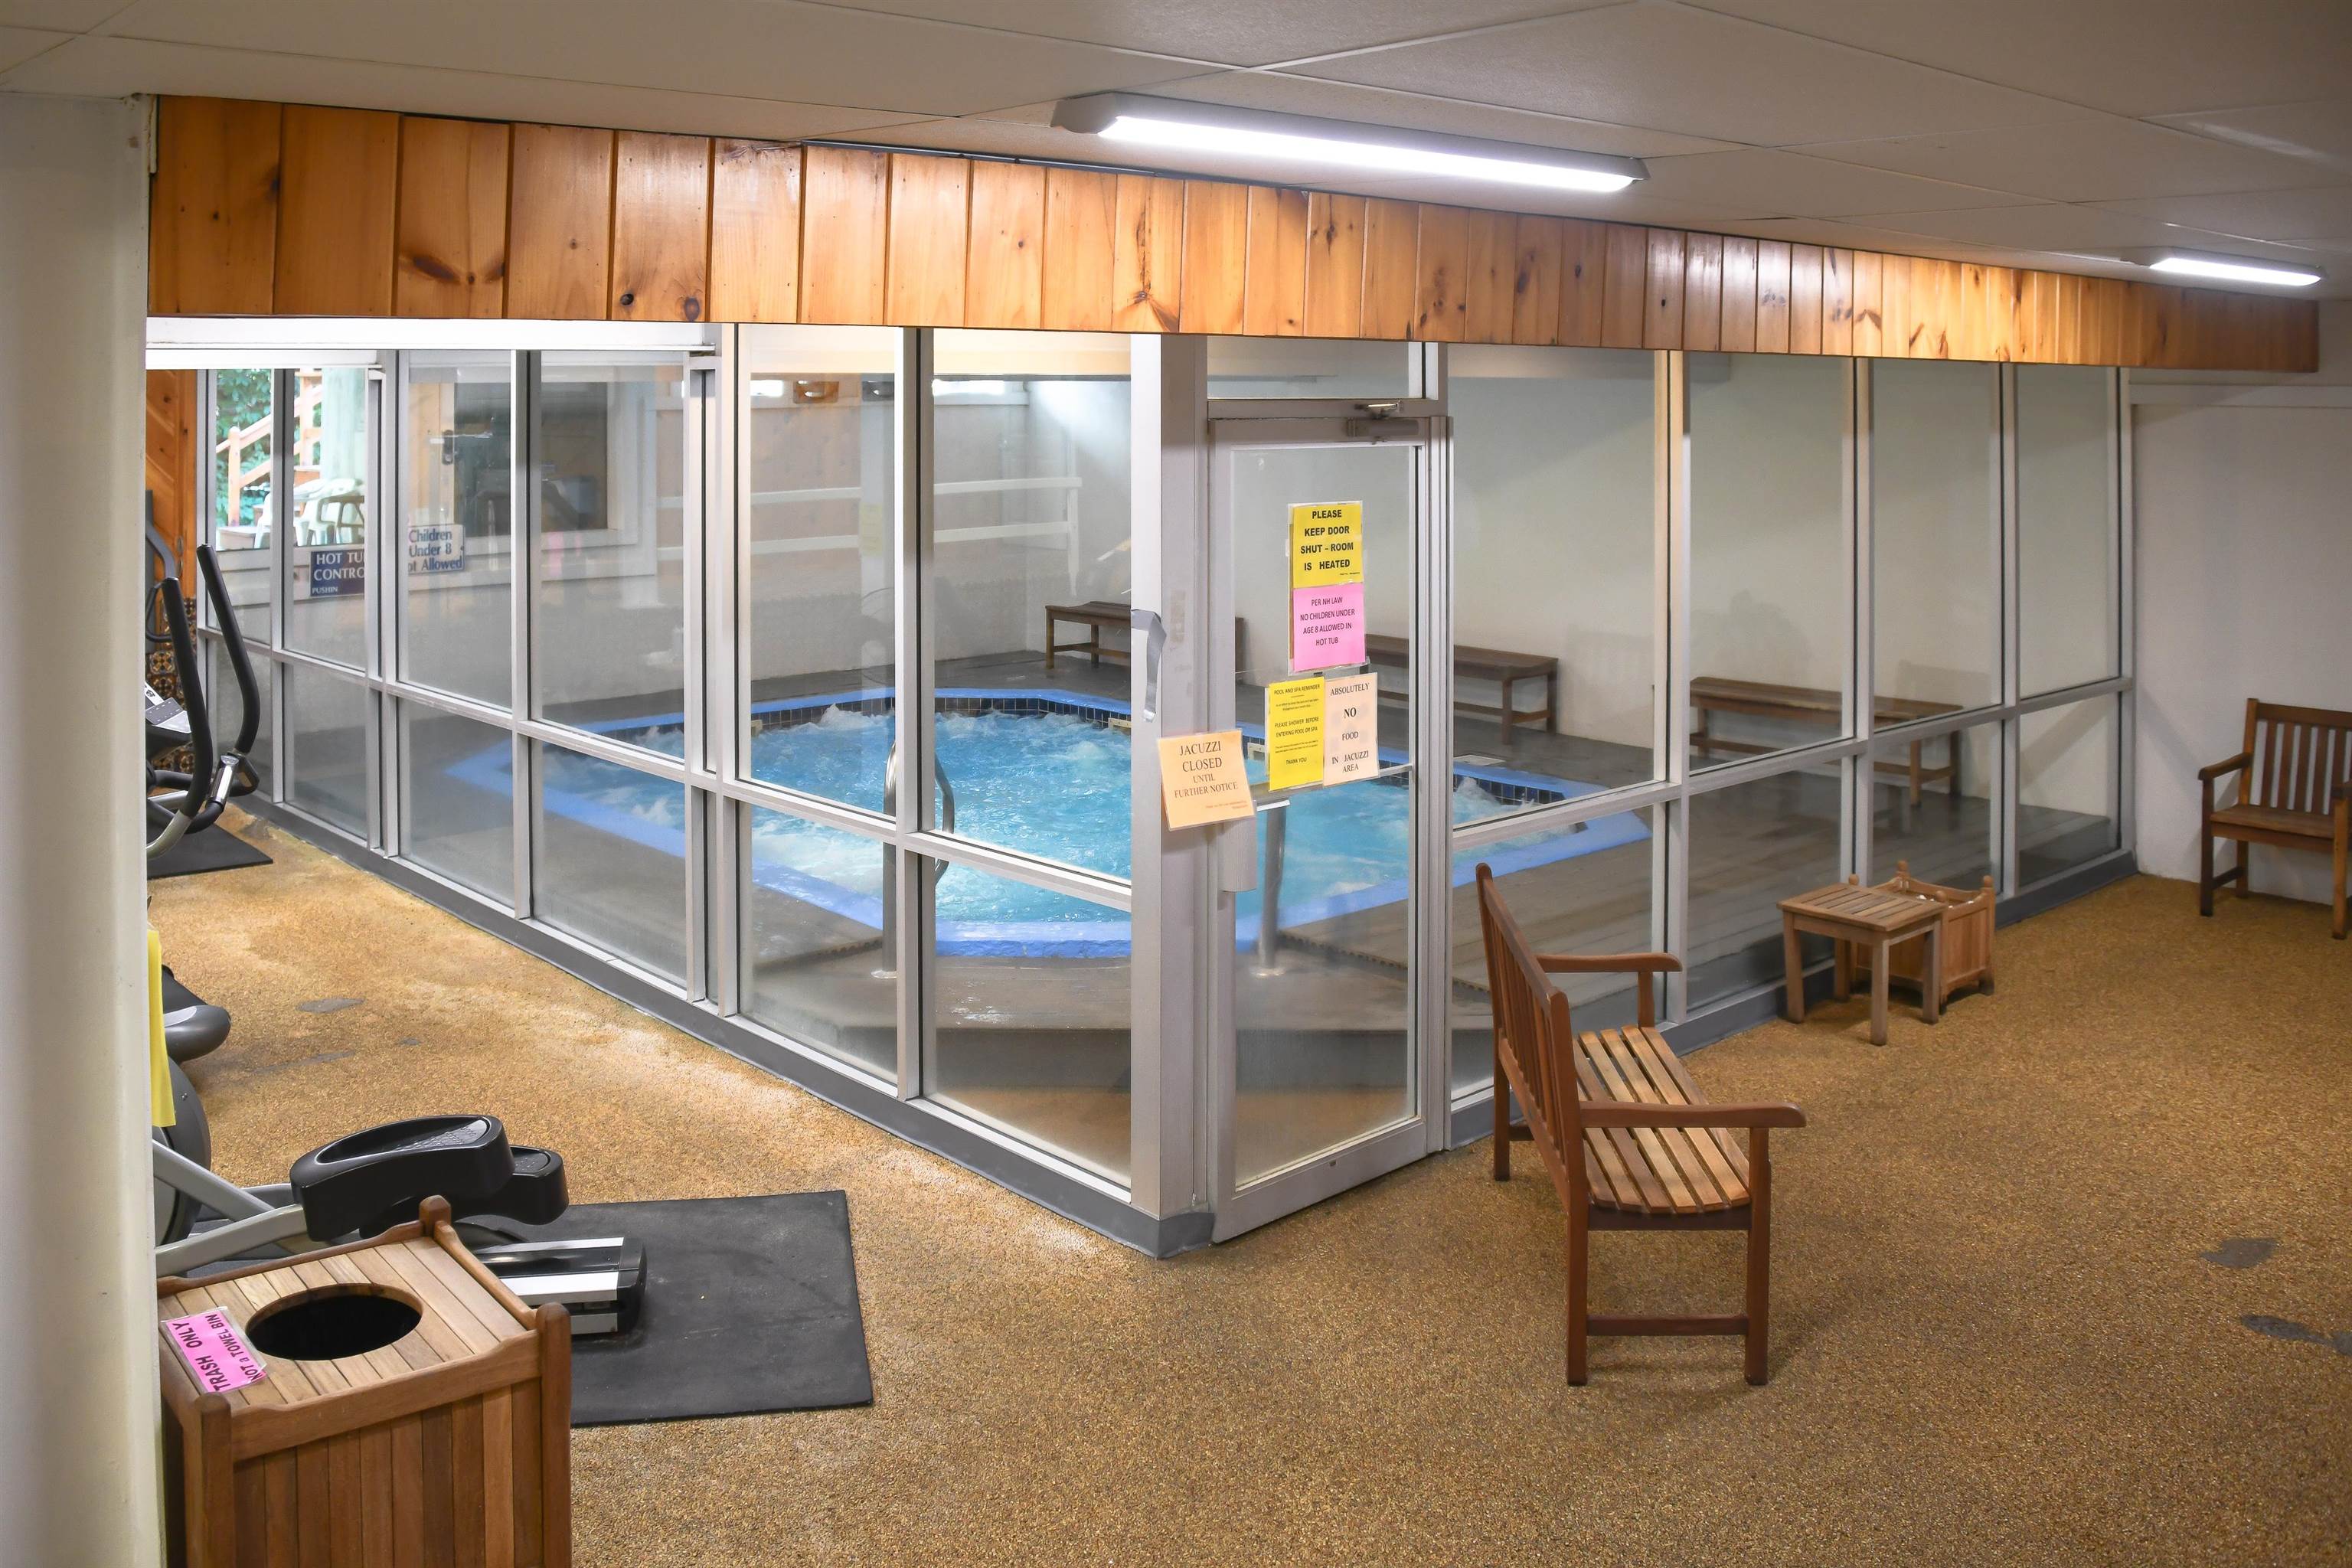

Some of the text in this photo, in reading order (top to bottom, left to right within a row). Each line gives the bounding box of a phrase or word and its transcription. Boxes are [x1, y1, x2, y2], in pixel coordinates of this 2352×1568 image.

[1312, 510, 1341, 519] PLEASE
[409, 528, 452, 543] Children
[1305, 526, 1349, 536] KEEP DOOR
[409, 543, 451, 557] Under 8
[1301, 545, 1323, 554] SHUT
[1331, 542, 1353, 552] ROOM
[316, 551, 364, 565] HOT TU
[421, 555, 462, 571] Allowed
[1304, 559, 1350, 571] IS HEATED
[1310, 611, 1335, 620] CHILDREN
[1336, 609, 1355, 617] UNDER
[1303, 626, 1314, 634] AGE
[1319, 623, 1345, 632] ALLOWED
[1330, 683, 1370, 696] ABSOLUTELY
[1344, 707, 1357, 719] NO
[1342, 731, 1359, 741] FOOD
[1179, 741, 1222, 756] JACUZZI
[1332, 750, 1369, 764] IN JACUZZI
[1182, 757, 1222, 772] CLOSED
[1343, 763, 1359, 773] AREA
[1193, 773, 1216, 784] UNTIL
[1174, 782, 1238, 798] FURTHER NOTICE
[205, 1314, 225, 1330] BIN
[218, 1329, 244, 1358] TOWEL
[173, 1322, 231, 1391] TRASH ONLY
[240, 1364, 263, 1381] NOT
